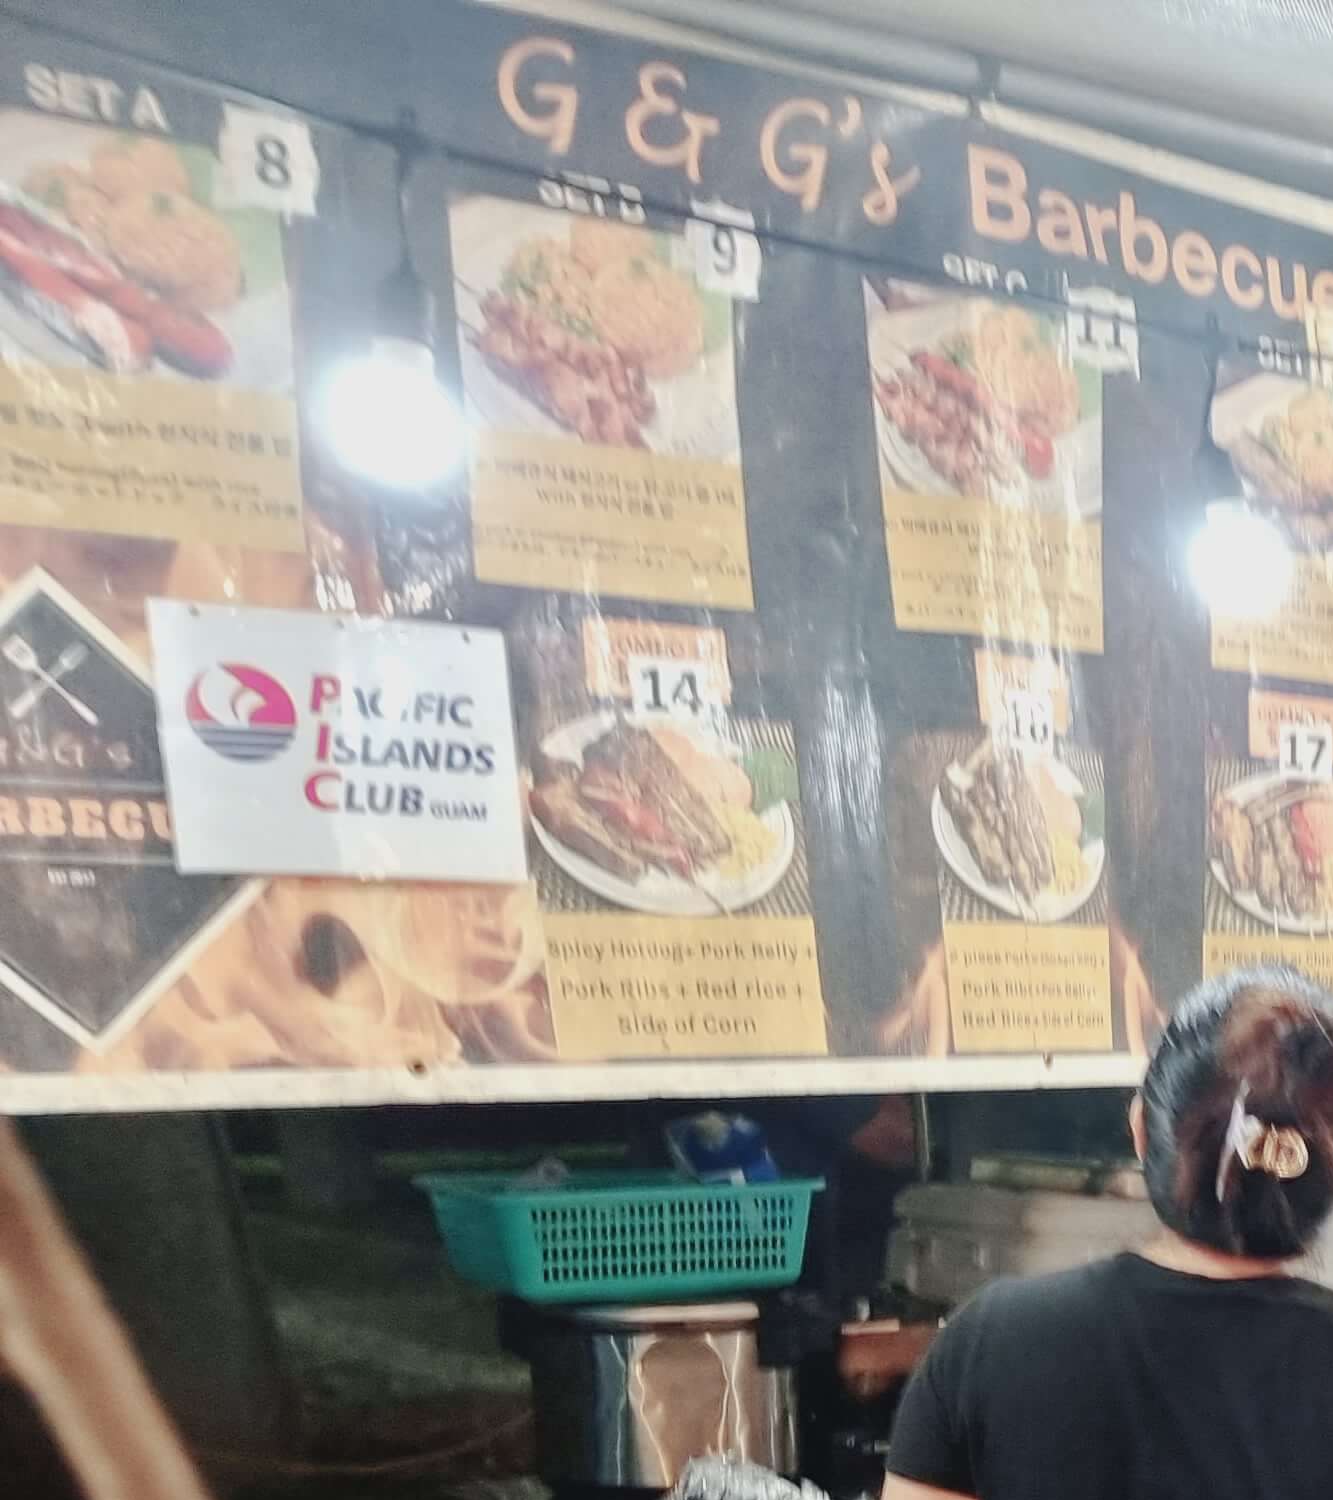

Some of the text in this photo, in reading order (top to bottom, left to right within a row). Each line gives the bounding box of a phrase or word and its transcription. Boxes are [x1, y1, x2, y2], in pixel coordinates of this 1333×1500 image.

[24, 62, 171, 133] SET A
[497, 34, 579, 156] G
[625, 61, 721, 184] &
[759, 97, 921, 226] G's
[254, 133, 291, 188] 8
[712, 225, 737, 274] 9
[640, 665, 701, 716] 14
[316, 721, 496, 777] ISLANDS
[1285, 732, 1328, 773] 17
[304, 769, 424, 818] CLUB
[701, 939, 745, 961] Pork
[560, 976, 615, 1001] Pork
[619, 976, 671, 1001] Ribs
[695, 976, 739, 1000] Red
[616, 1013, 758, 1036] Side of Corn
